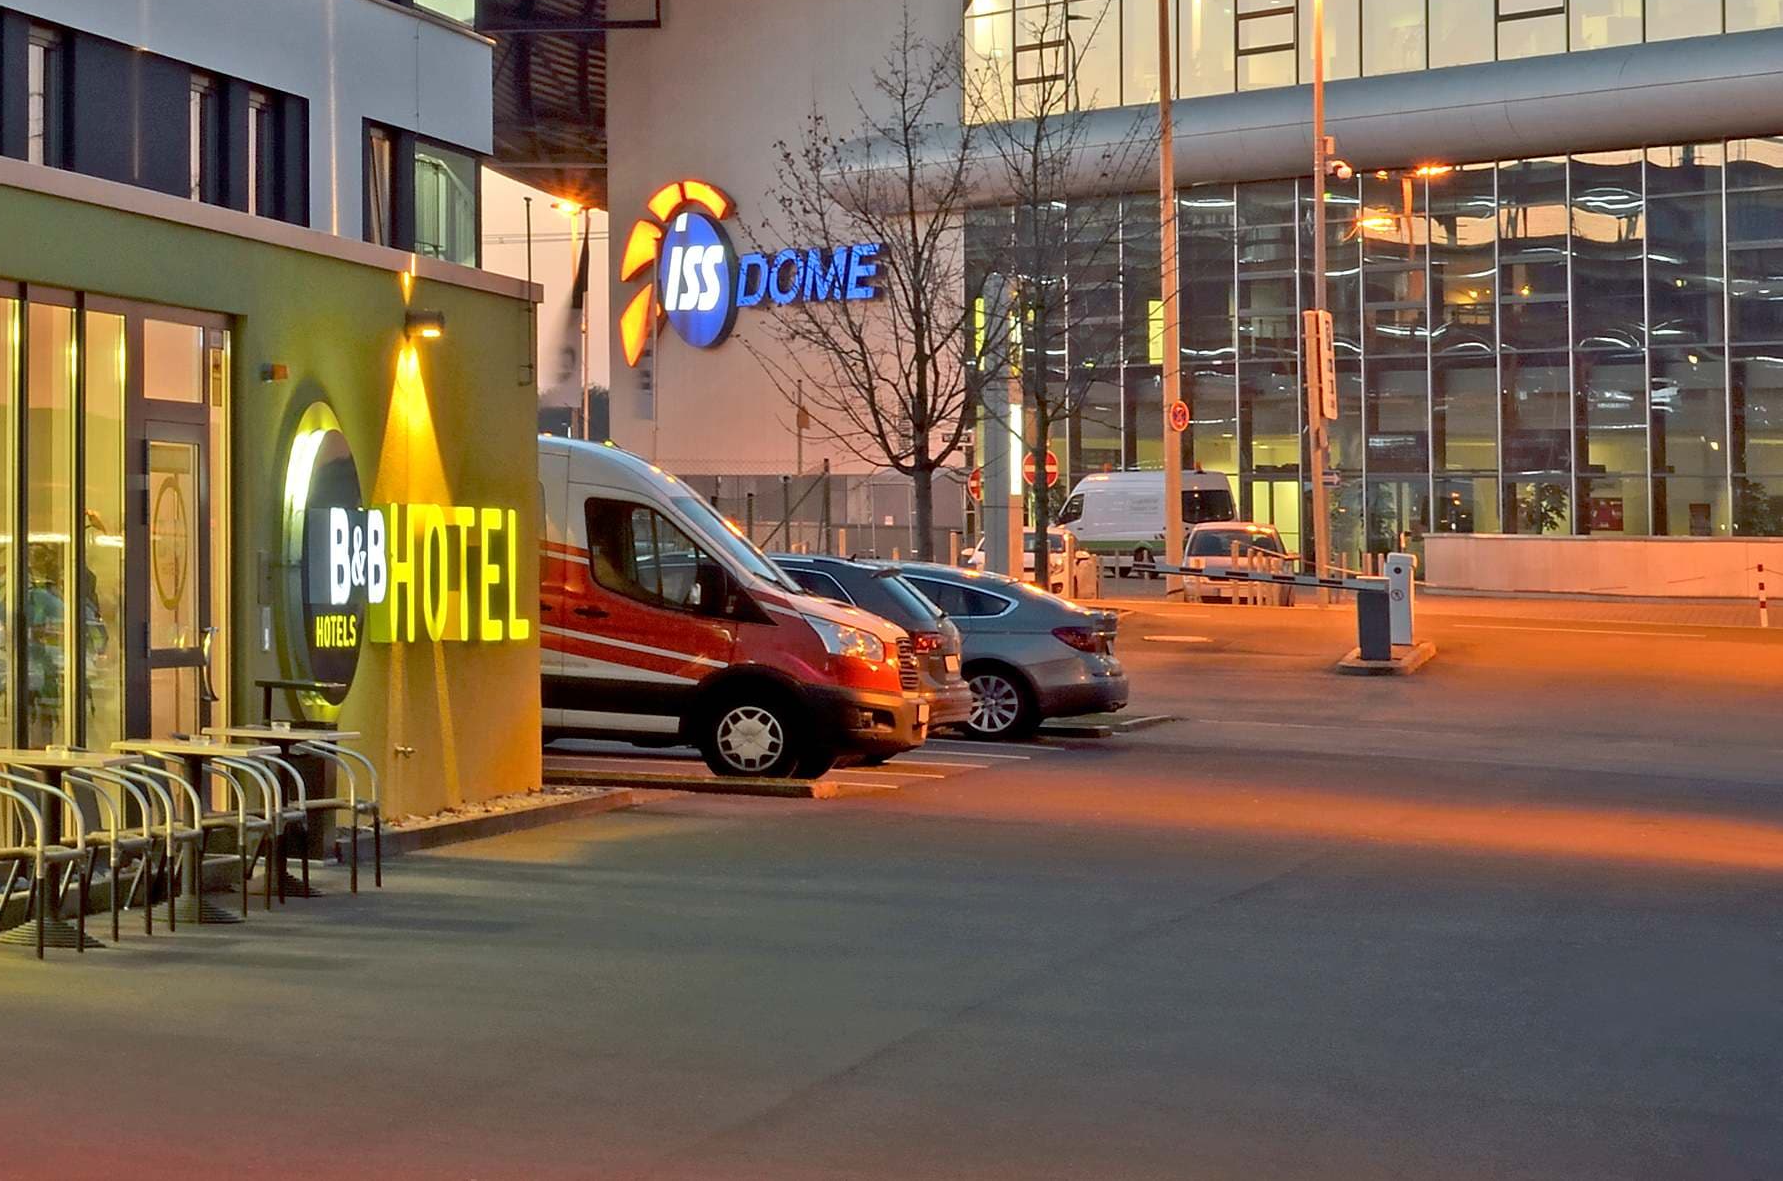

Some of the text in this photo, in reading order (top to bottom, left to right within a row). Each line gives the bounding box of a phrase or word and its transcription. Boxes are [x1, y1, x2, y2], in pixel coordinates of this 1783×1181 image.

[736, 243, 880, 308] DOME
[329, 502, 530, 643] B&B HOTEL
[315, 614, 357, 649] HOTELS
